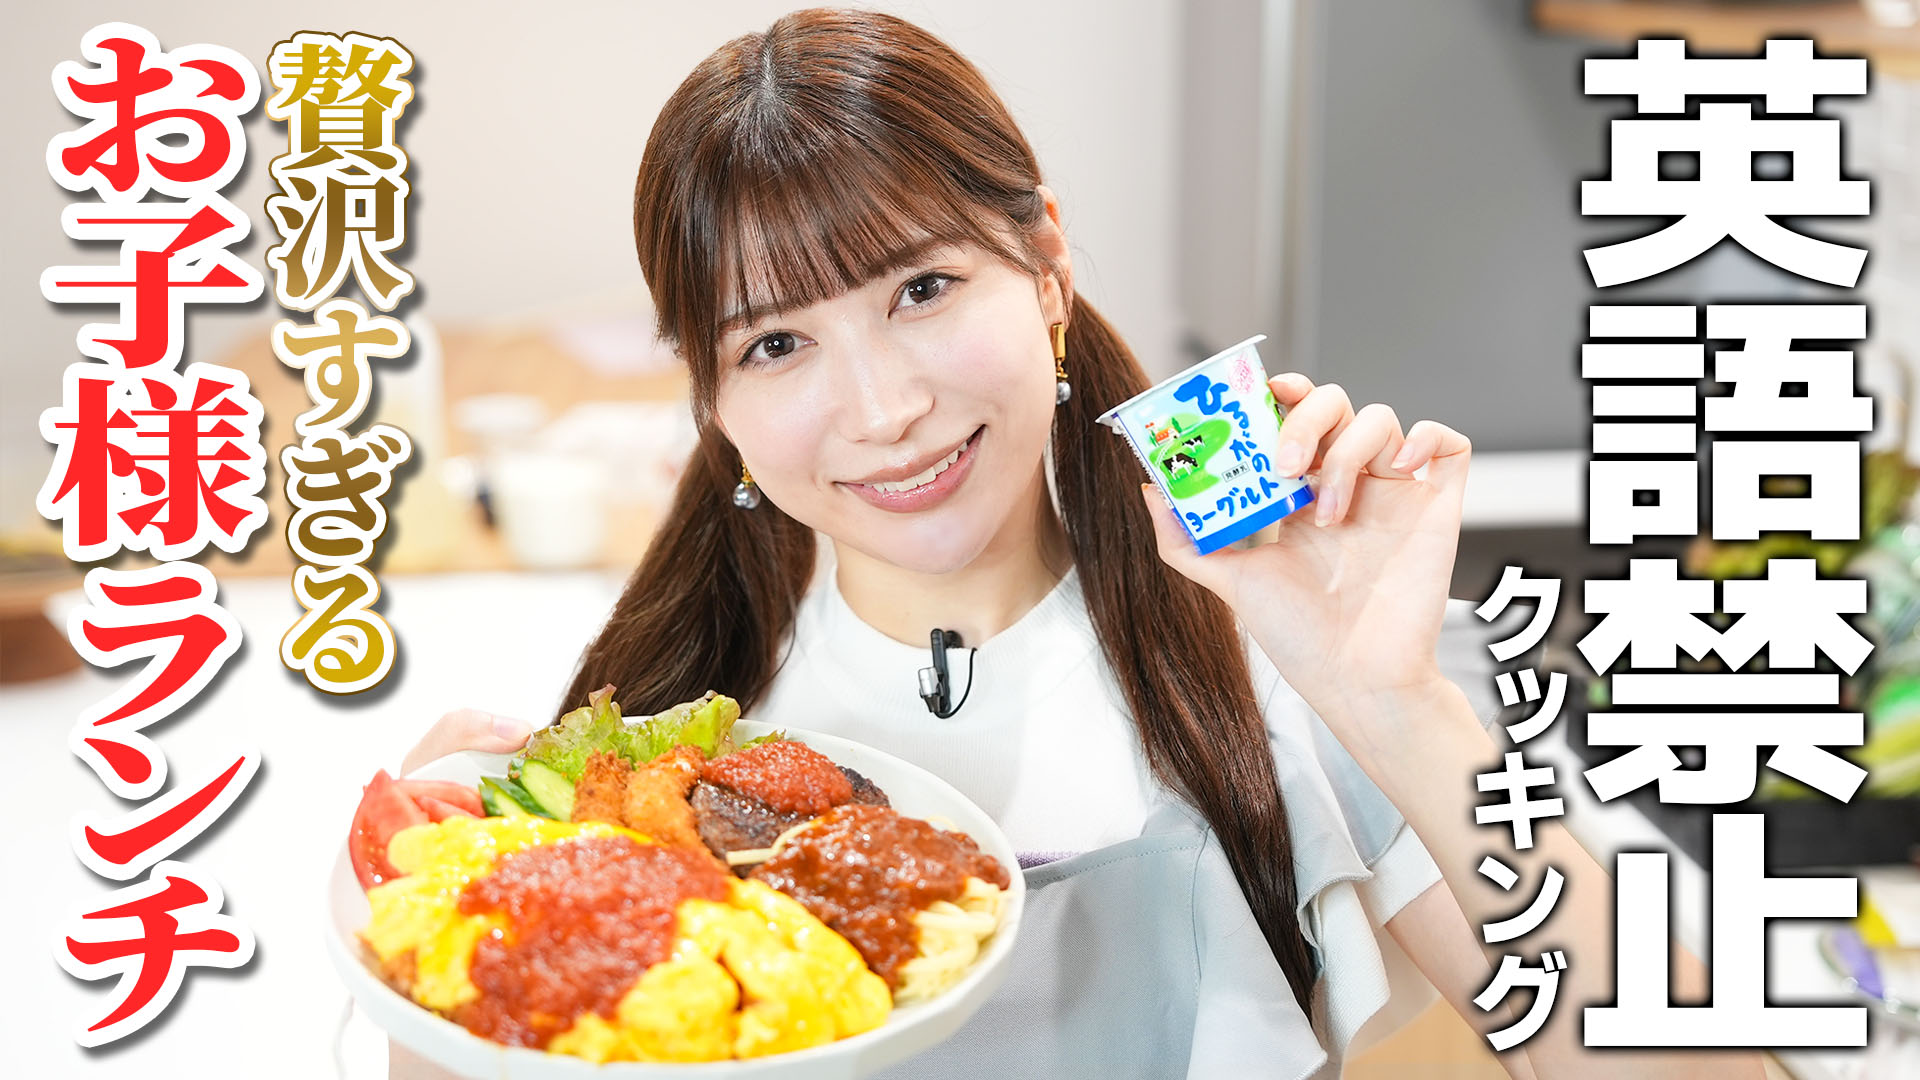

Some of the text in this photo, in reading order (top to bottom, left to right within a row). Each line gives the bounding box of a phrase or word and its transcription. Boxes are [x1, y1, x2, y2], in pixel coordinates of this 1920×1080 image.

[1185, 476, 1279, 533] ヨーグルト
